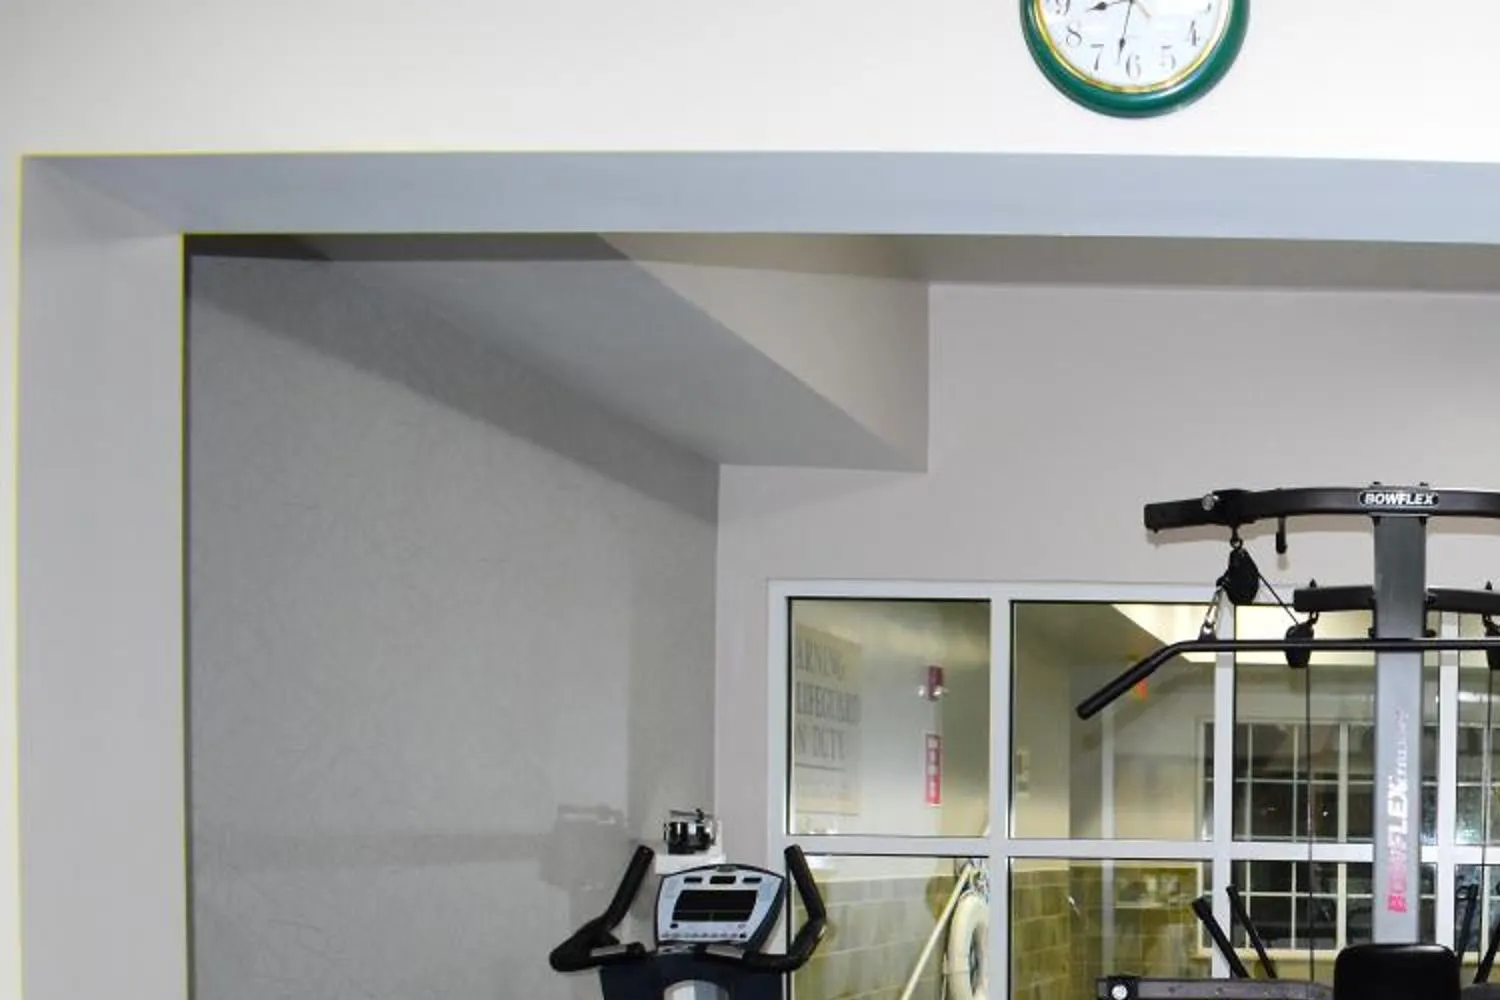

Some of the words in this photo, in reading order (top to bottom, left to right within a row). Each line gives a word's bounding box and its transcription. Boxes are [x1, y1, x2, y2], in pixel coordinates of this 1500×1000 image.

[1065, 23, 1083, 47] 8
[1187, 19, 1201, 47] 4
[1090, 43, 1105, 71] 7
[1125, 54, 1142, 81] 6
[1160, 44, 1177, 71] 5
[1364, 493, 1434, 505] BOWFLEX
